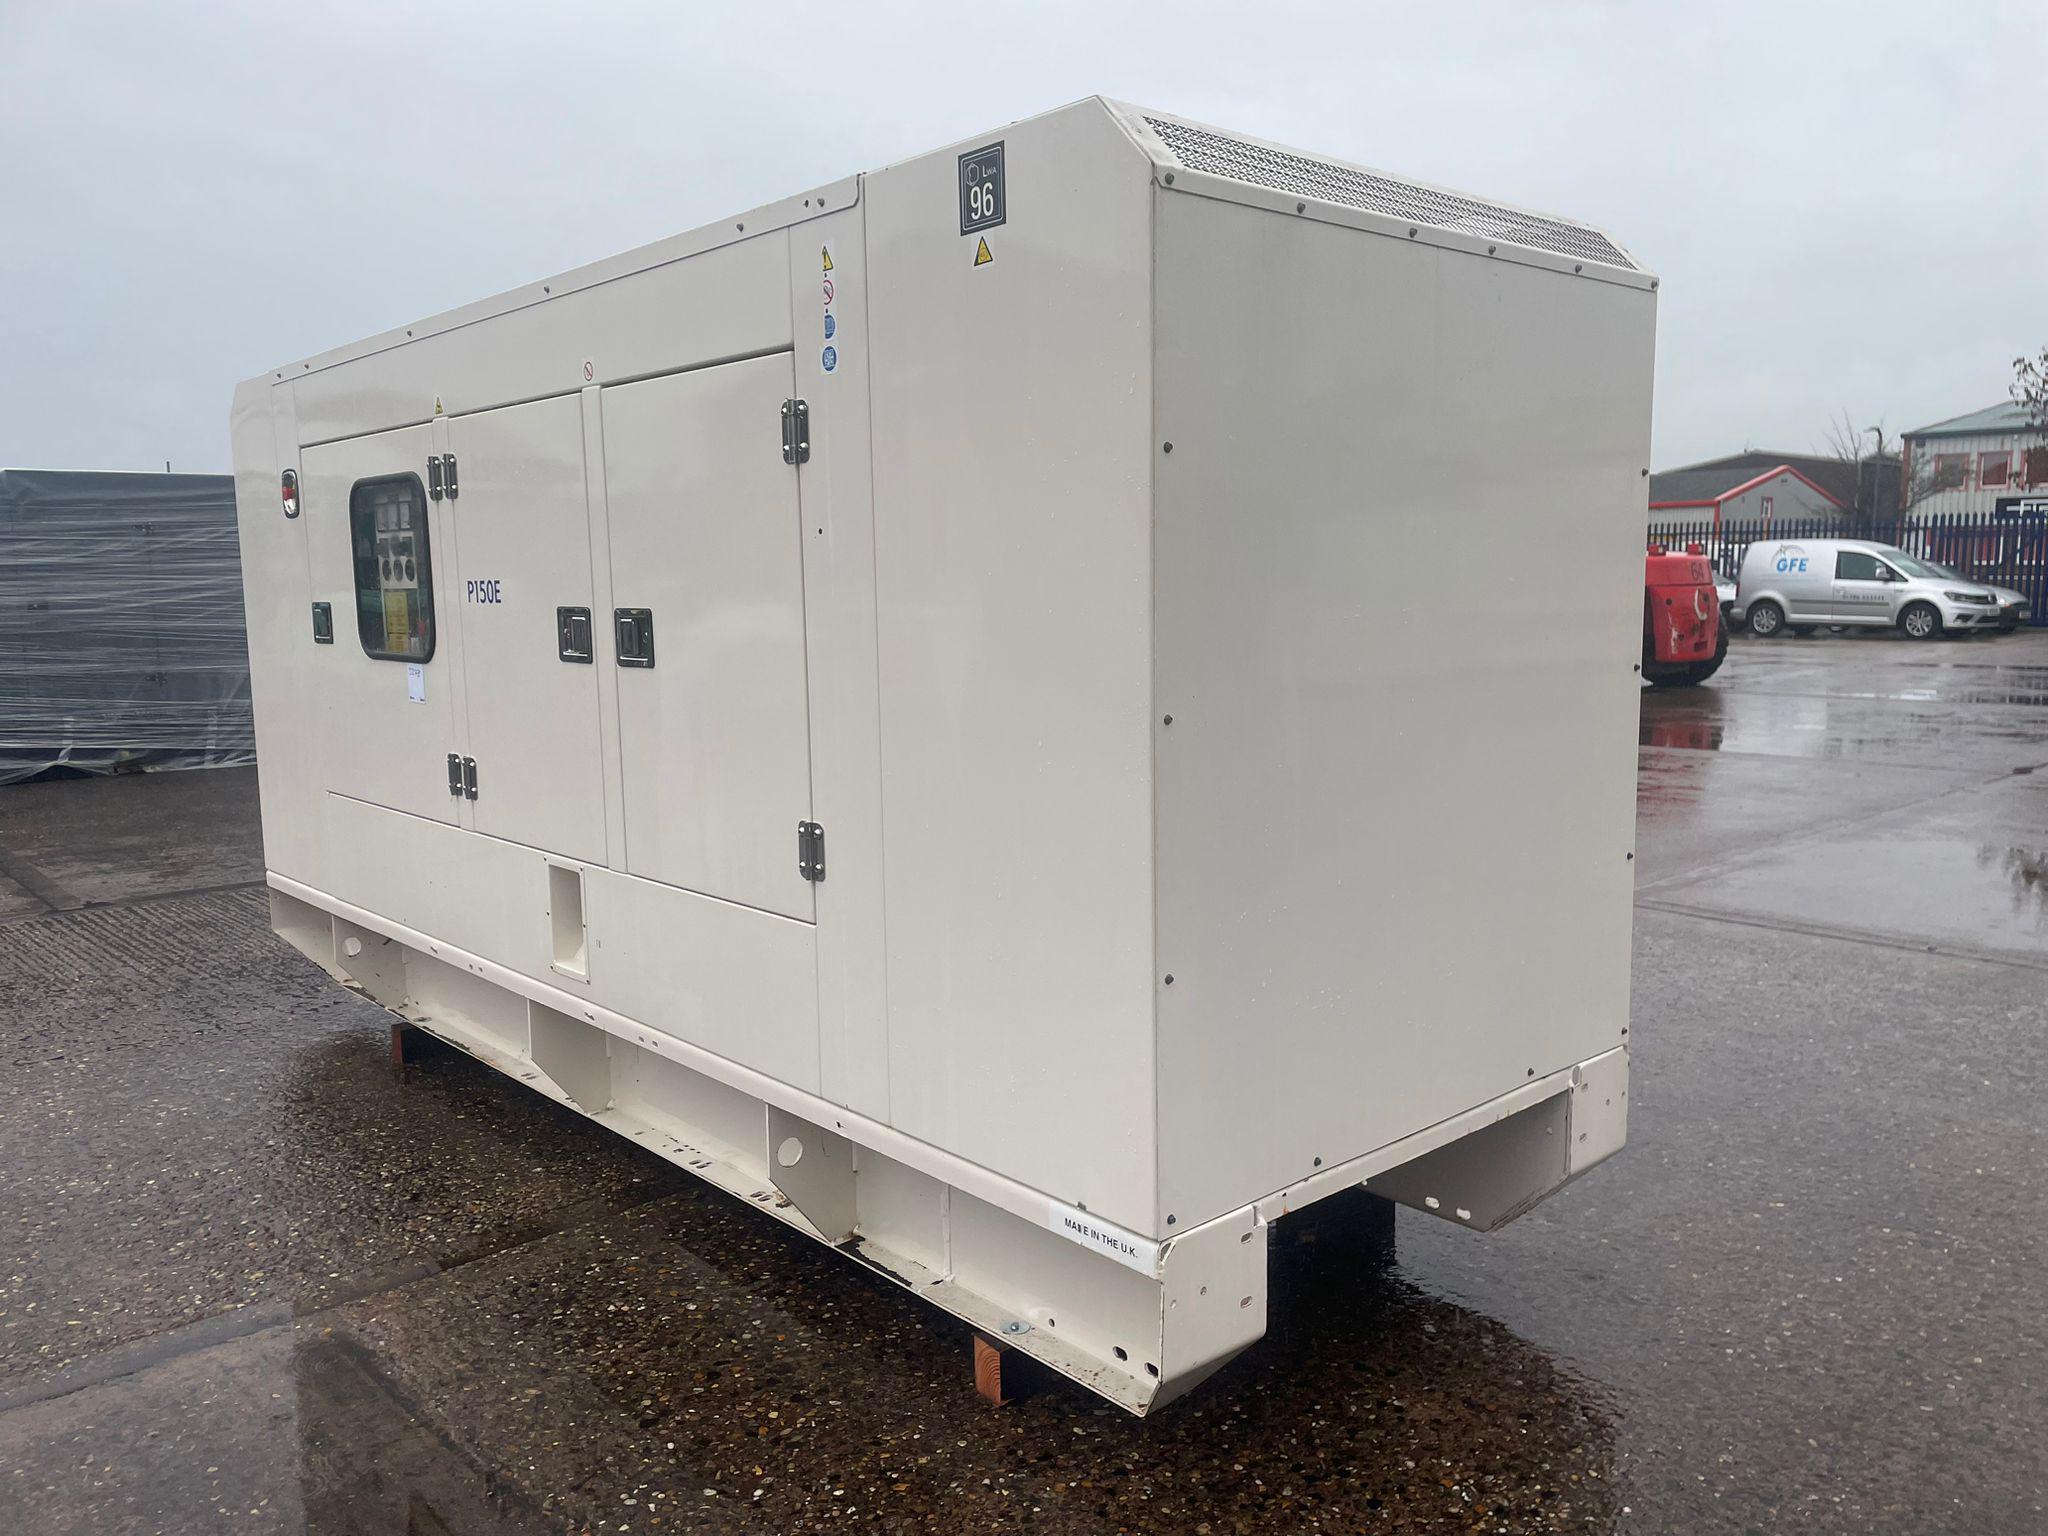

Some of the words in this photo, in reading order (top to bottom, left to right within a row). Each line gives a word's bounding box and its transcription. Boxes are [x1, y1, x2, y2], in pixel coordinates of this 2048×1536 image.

[970, 182, 994, 220] 96
[1777, 557, 1808, 573] GFE
[467, 580, 502, 604] P150E
[1091, 1229, 1100, 1241] IN
[1101, 1234, 1118, 1250] THE
[1121, 1243, 1138, 1258] U.K.
